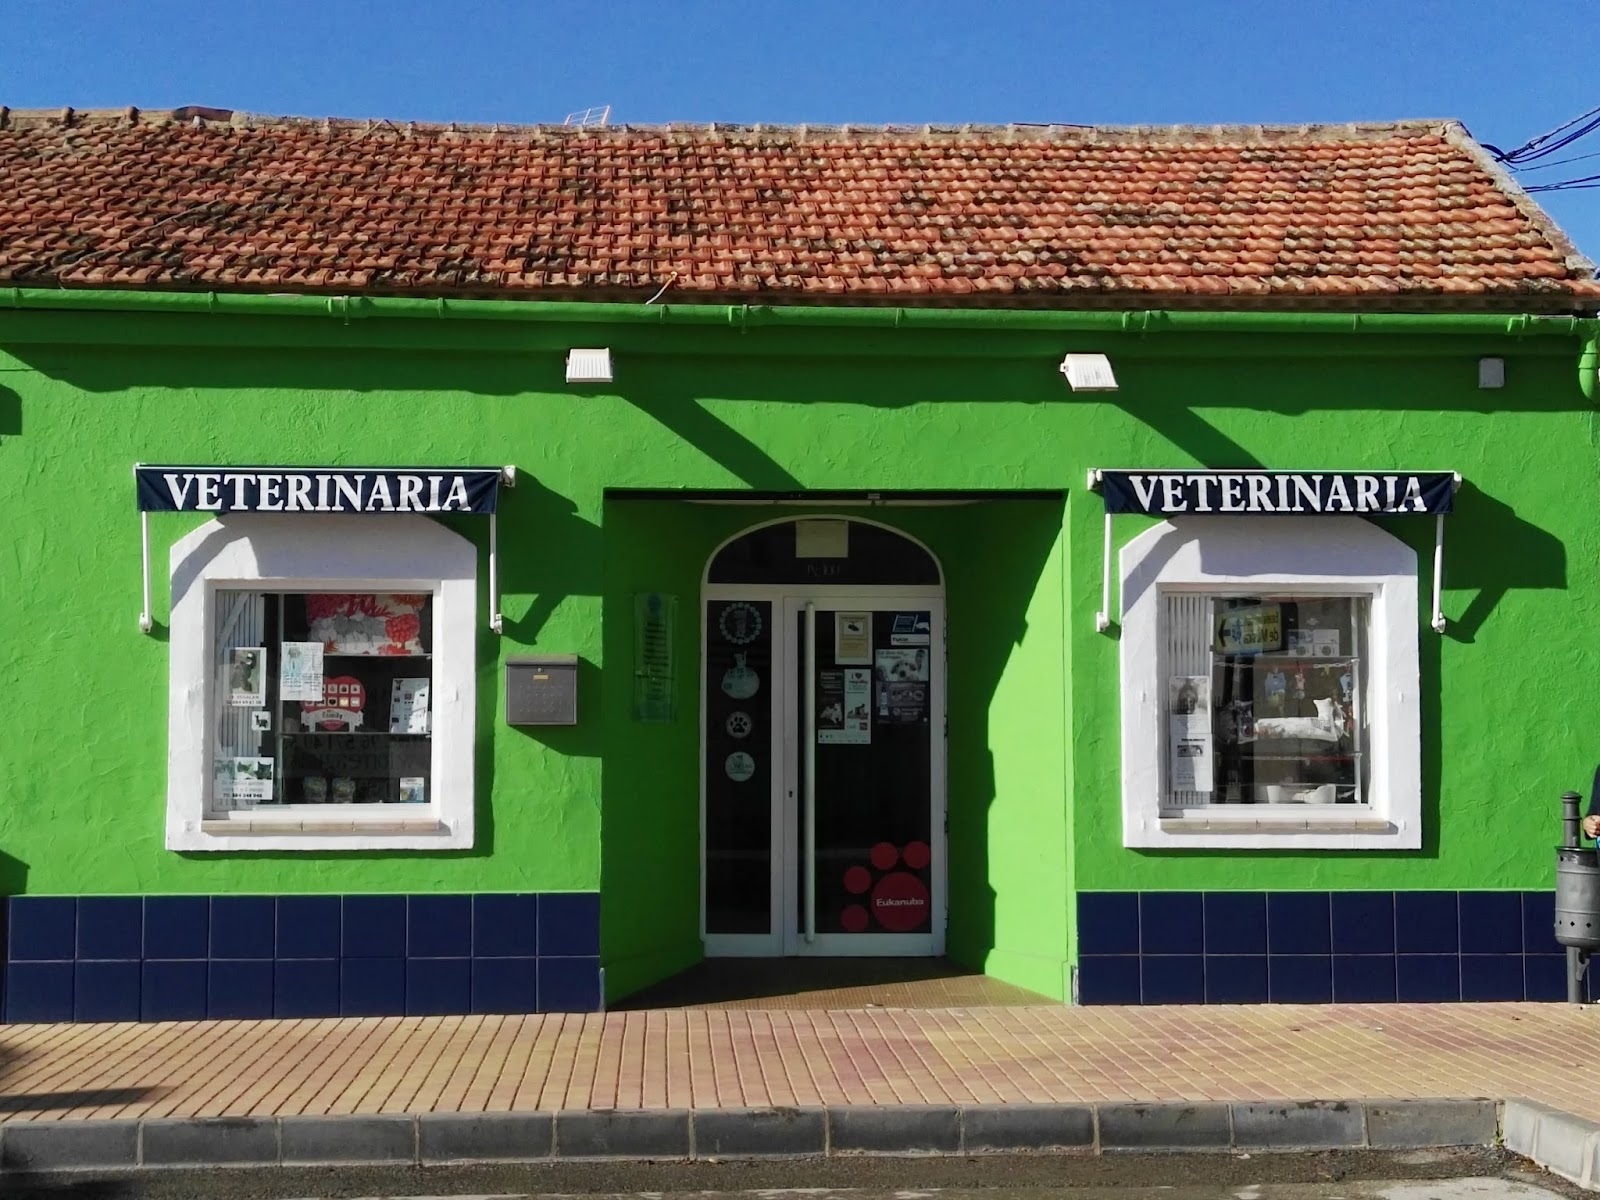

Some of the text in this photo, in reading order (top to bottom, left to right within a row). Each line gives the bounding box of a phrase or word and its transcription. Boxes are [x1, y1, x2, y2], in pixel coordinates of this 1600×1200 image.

[163, 473, 472, 512] VETERINARIA
[1128, 474, 1428, 512] VETERINARIA
[876, 897, 924, 907] Eukanuba
